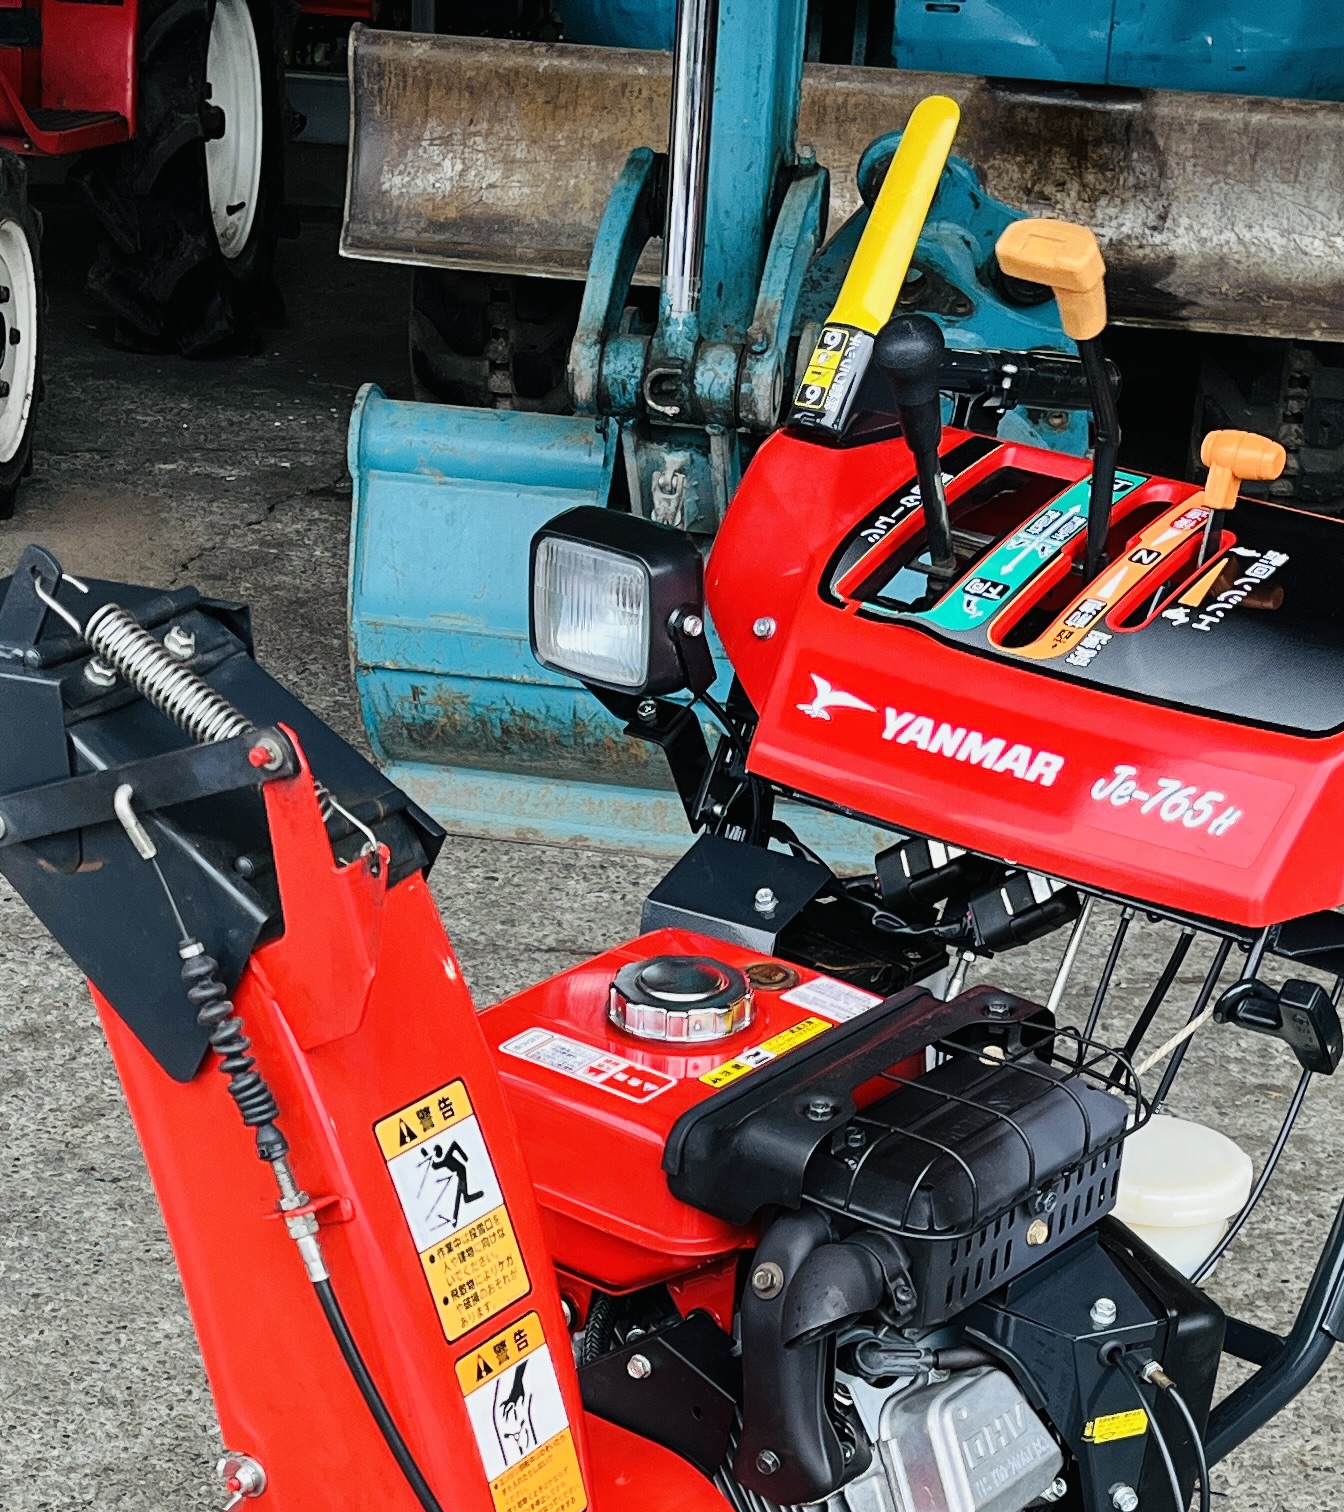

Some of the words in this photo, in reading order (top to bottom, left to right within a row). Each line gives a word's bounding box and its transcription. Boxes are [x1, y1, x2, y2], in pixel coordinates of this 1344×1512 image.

[1132, 549, 1157, 564] N
[882, 707, 1064, 787] YANMAR
[415, 1096, 455, 1133] 警告
[492, 1327, 530, 1367] 警告
